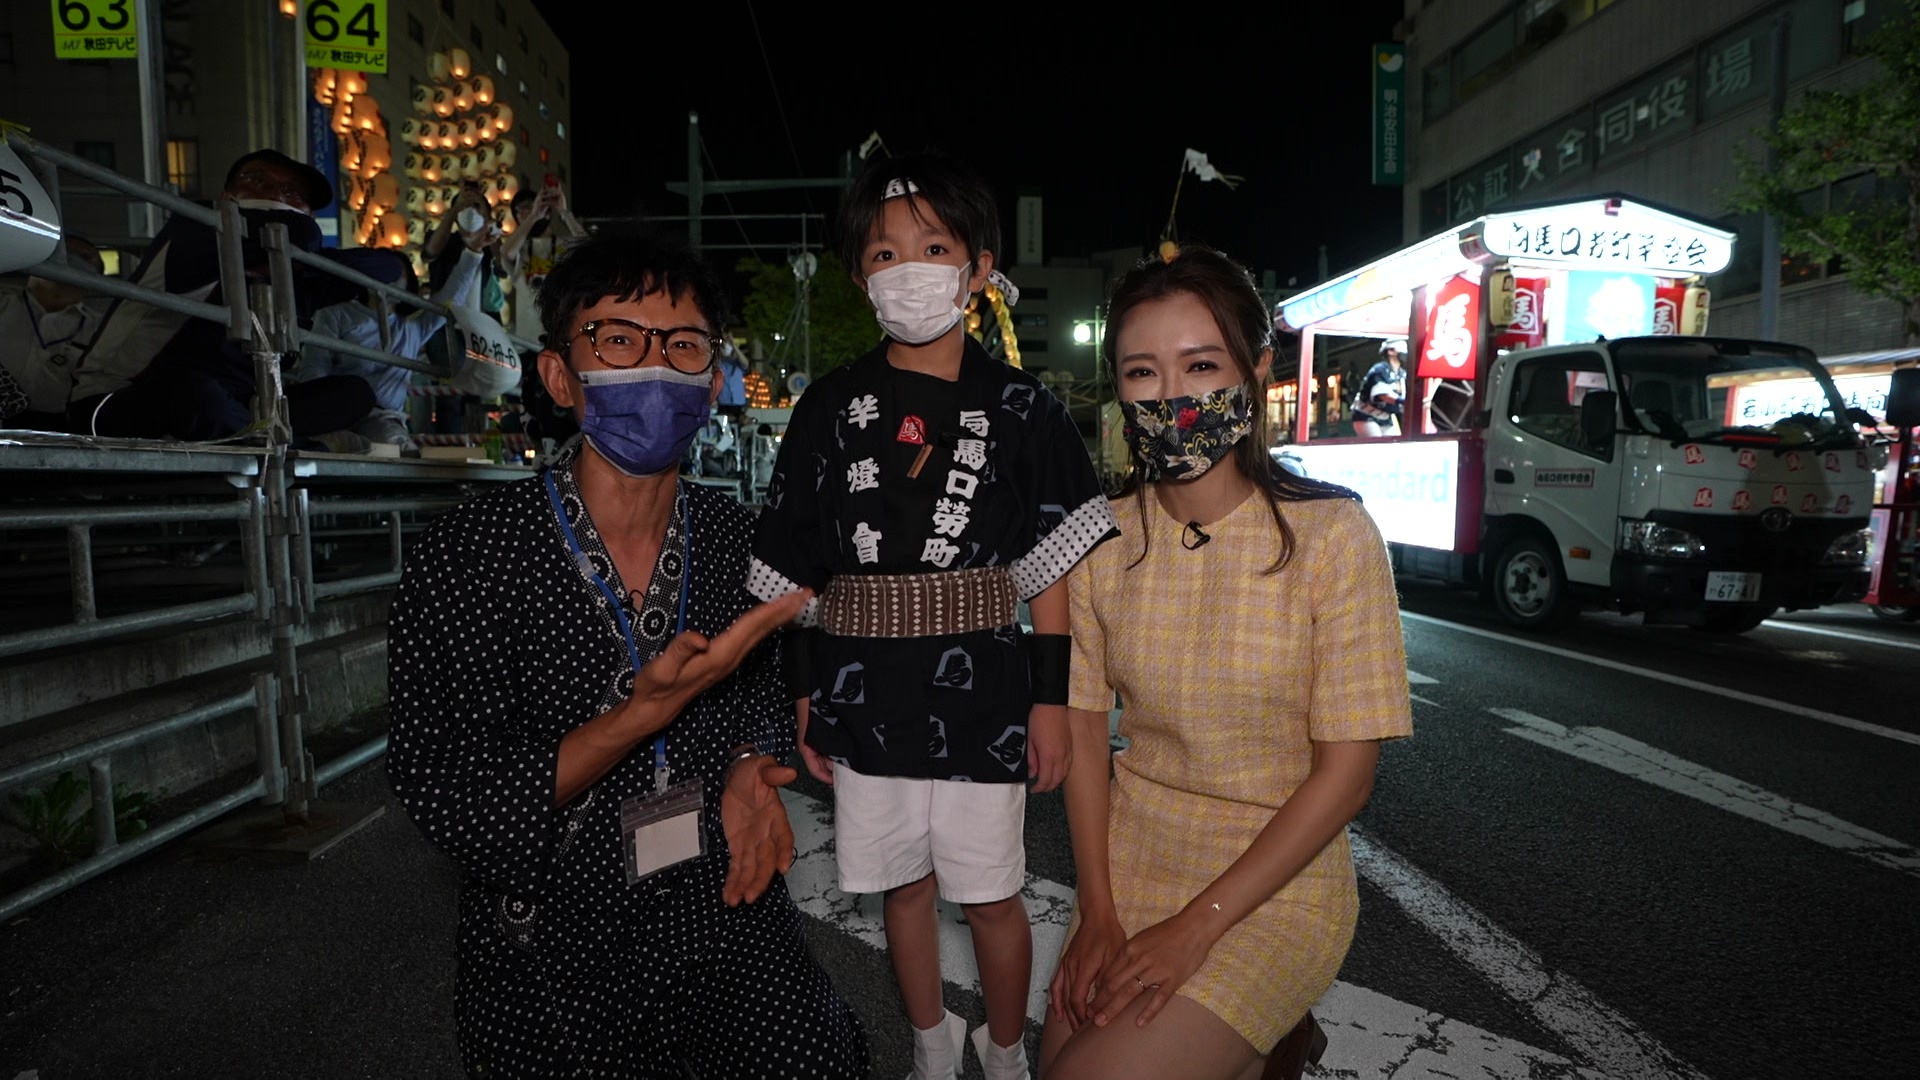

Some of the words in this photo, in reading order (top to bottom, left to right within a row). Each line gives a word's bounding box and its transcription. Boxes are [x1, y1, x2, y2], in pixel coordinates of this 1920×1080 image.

[58, 0, 130, 31] 63
[306, 0, 381, 47] 64
[84, 36, 136, 51] 秋田テレビ
[331, 48, 385, 67] 秋田テレビ
[1383, 88, 1398, 174] 明治安田生命
[1425, 294, 1473, 368] 馬
